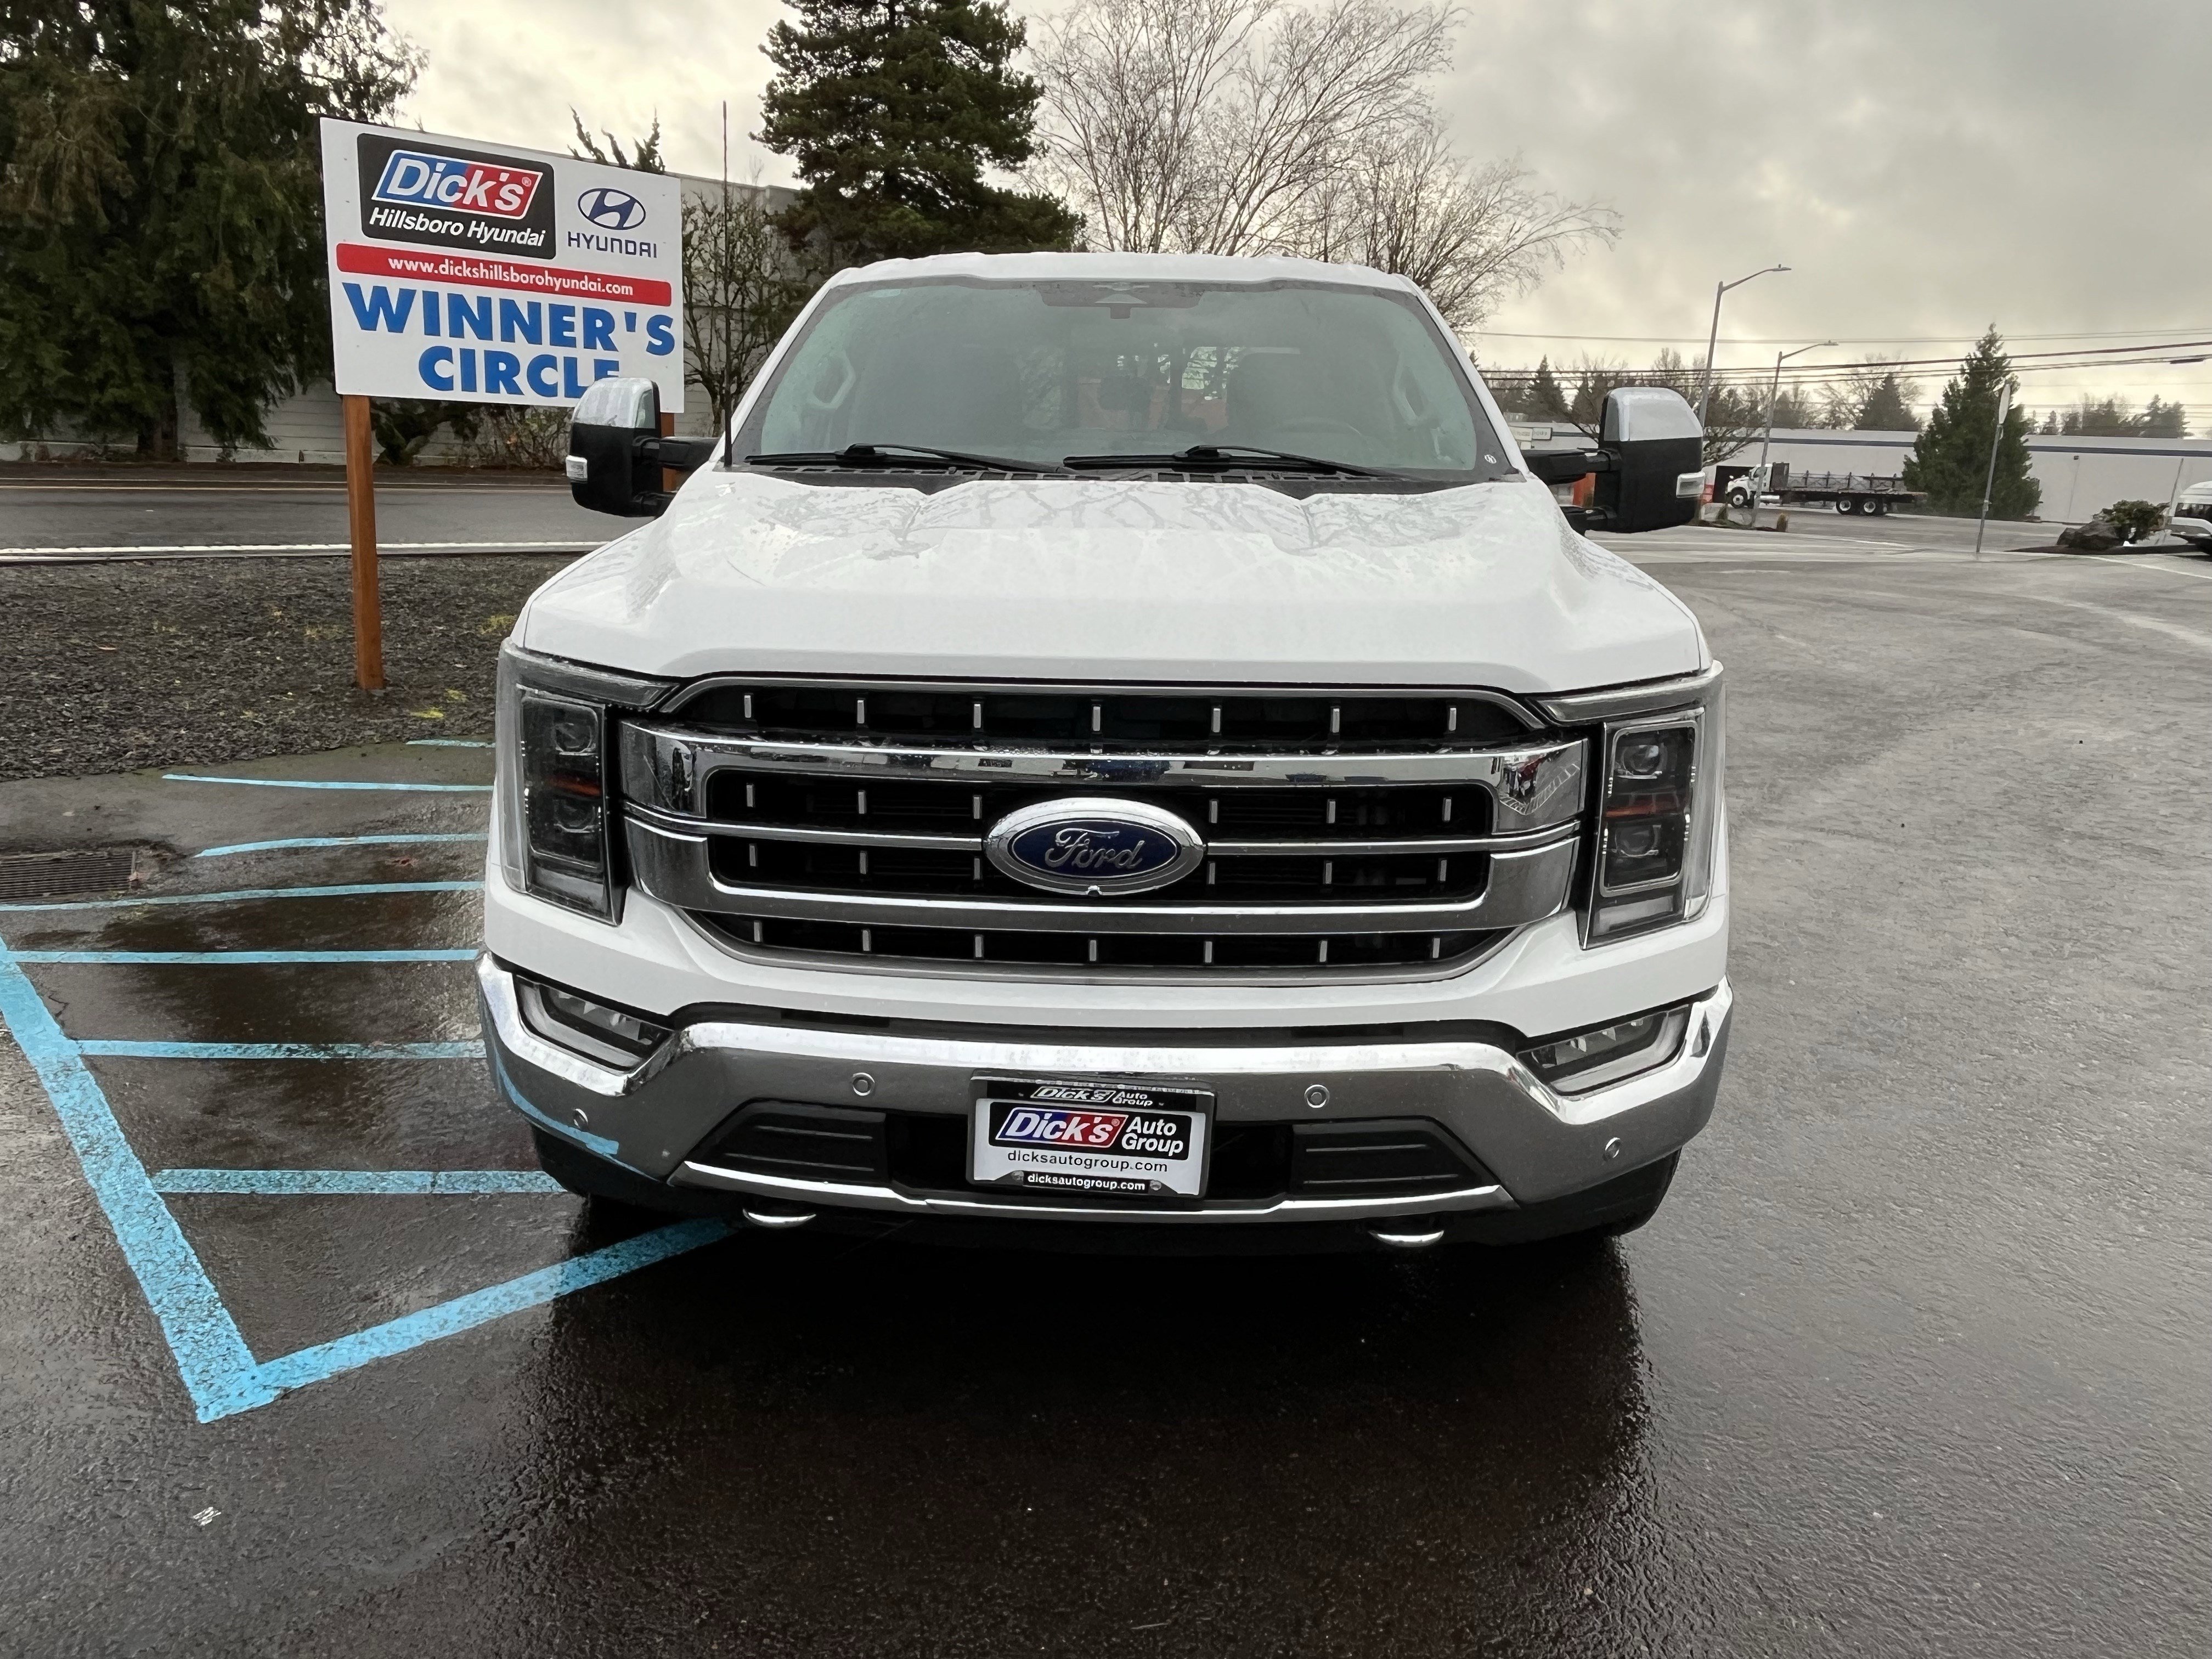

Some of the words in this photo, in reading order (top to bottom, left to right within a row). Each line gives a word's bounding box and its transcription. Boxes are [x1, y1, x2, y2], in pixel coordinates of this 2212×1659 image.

[386, 158, 524, 211] Dick's
[369, 207, 463, 237] Hillsboro
[467, 224, 546, 247] Hyundai
[567, 230, 657, 259] HYUNDAI
[388, 257, 634, 296] www.dickshillsborohyundai.com
[341, 281, 676, 356] WINNER'S
[1045, 827, 1146, 868] Ford
[1005, 1112, 1113, 1144] Dick's
[1126, 1116, 1177, 1136] Auto
[1121, 1133, 1184, 1156] Group
[1007, 1150, 1168, 1172] dicksautogroup.com
[1027, 1173, 1146, 1191] dicksautogroup.com
